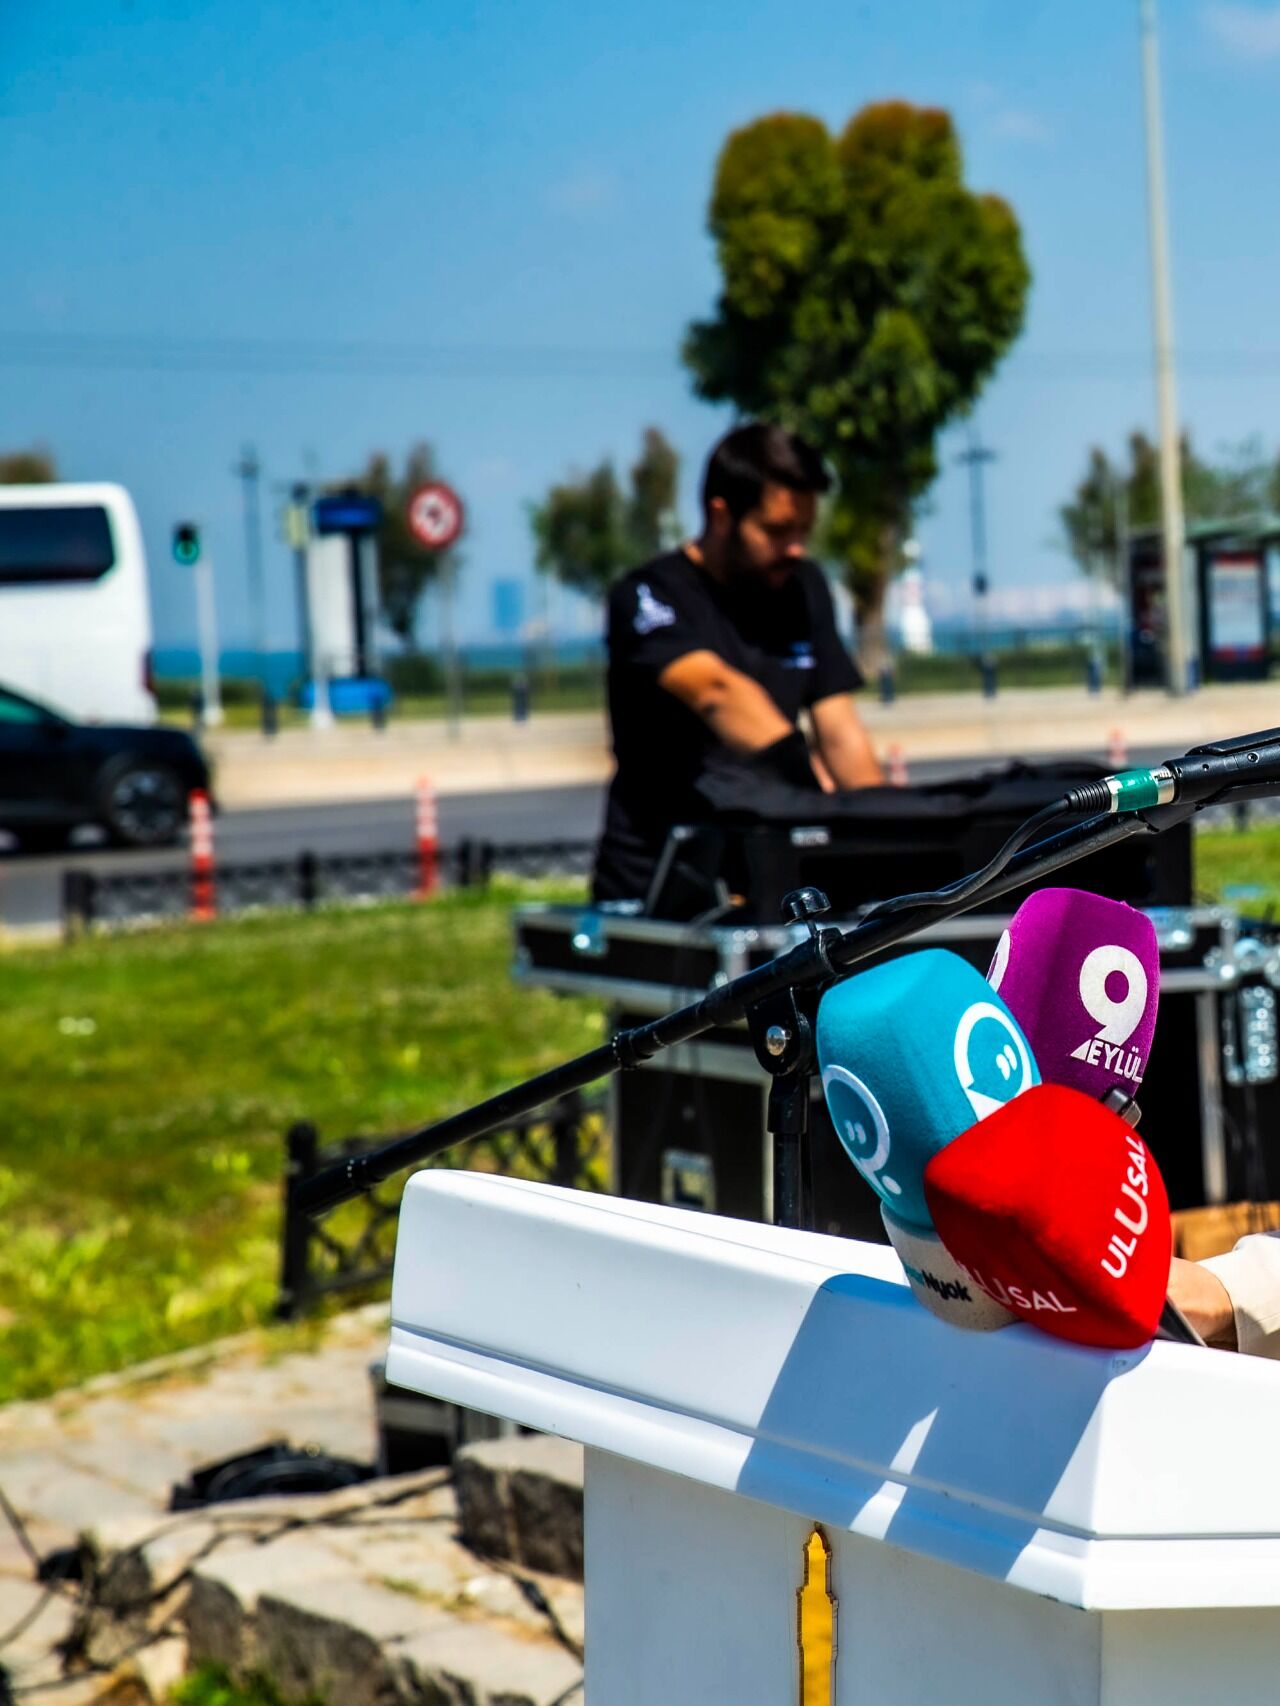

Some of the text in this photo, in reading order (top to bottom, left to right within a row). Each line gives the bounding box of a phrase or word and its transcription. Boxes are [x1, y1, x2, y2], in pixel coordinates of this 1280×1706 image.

[1079, 944, 1148, 1046] 9
[1086, 1040, 1143, 1084] EYLÜL
[1100, 1135, 1149, 1279] ULUSAL
